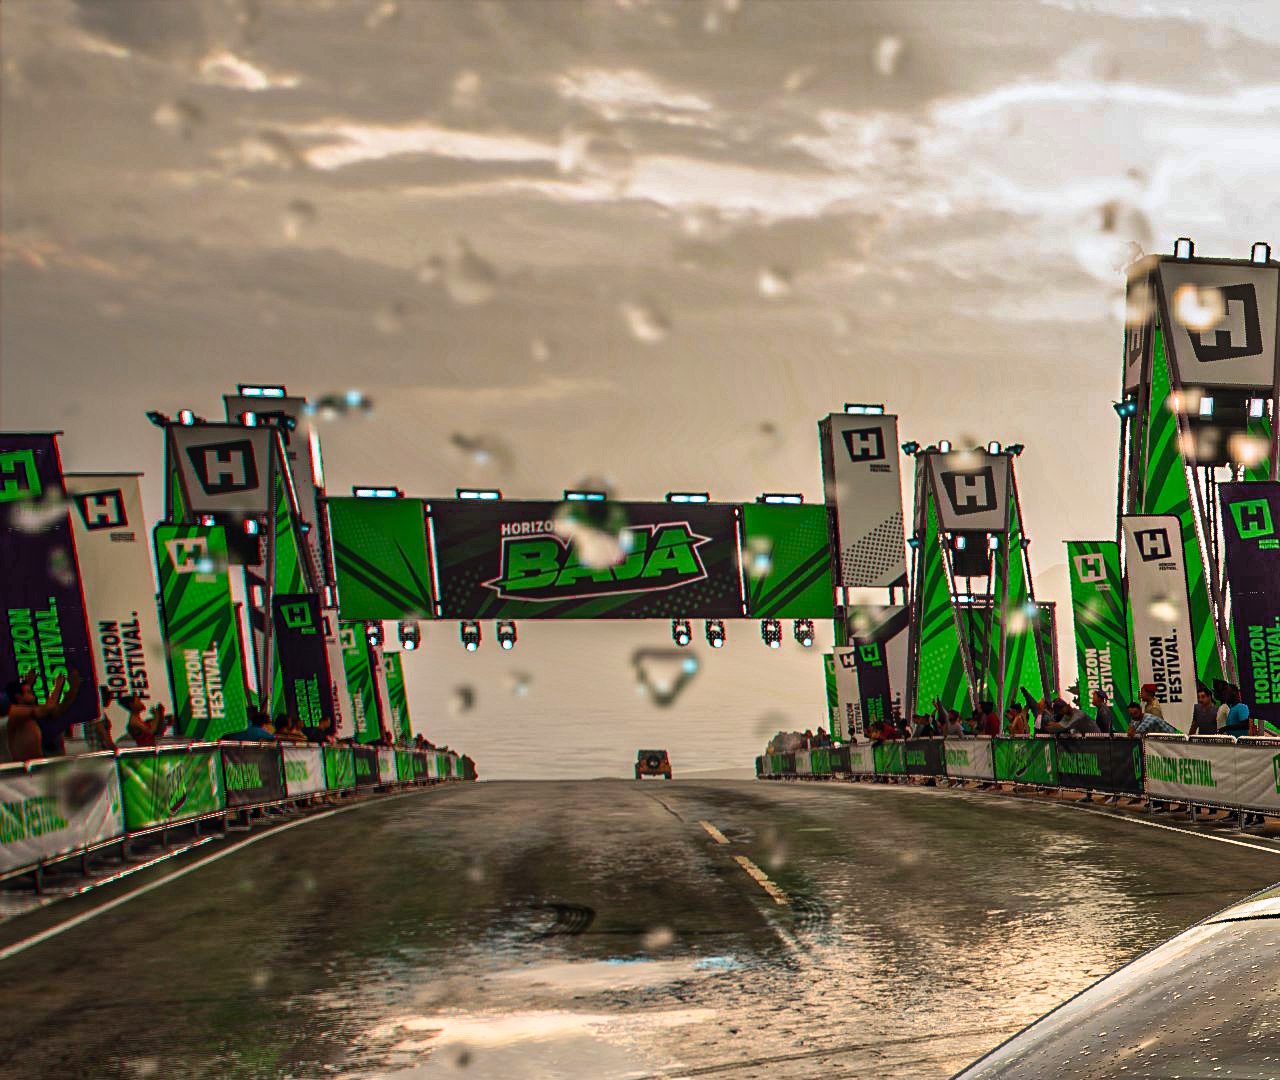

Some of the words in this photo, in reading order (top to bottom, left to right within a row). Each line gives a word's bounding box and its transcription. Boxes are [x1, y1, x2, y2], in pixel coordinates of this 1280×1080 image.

[851, 433, 877, 456] H
[205, 451, 246, 485] H
[954, 476, 986, 506] H
[84, 496, 119, 523] H
[1240, 505, 1266, 531] H
[501, 521, 558, 535] HORIZO
[1142, 533, 1166, 555] H
[99, 620, 128, 700] HORIZON
[1149, 636, 1167, 703] HORIZON
[1165, 628, 1182, 703] FESTIVAL.
[1249, 625, 1270, 704] HORIZON
[184, 648, 207, 719] HORIZON
